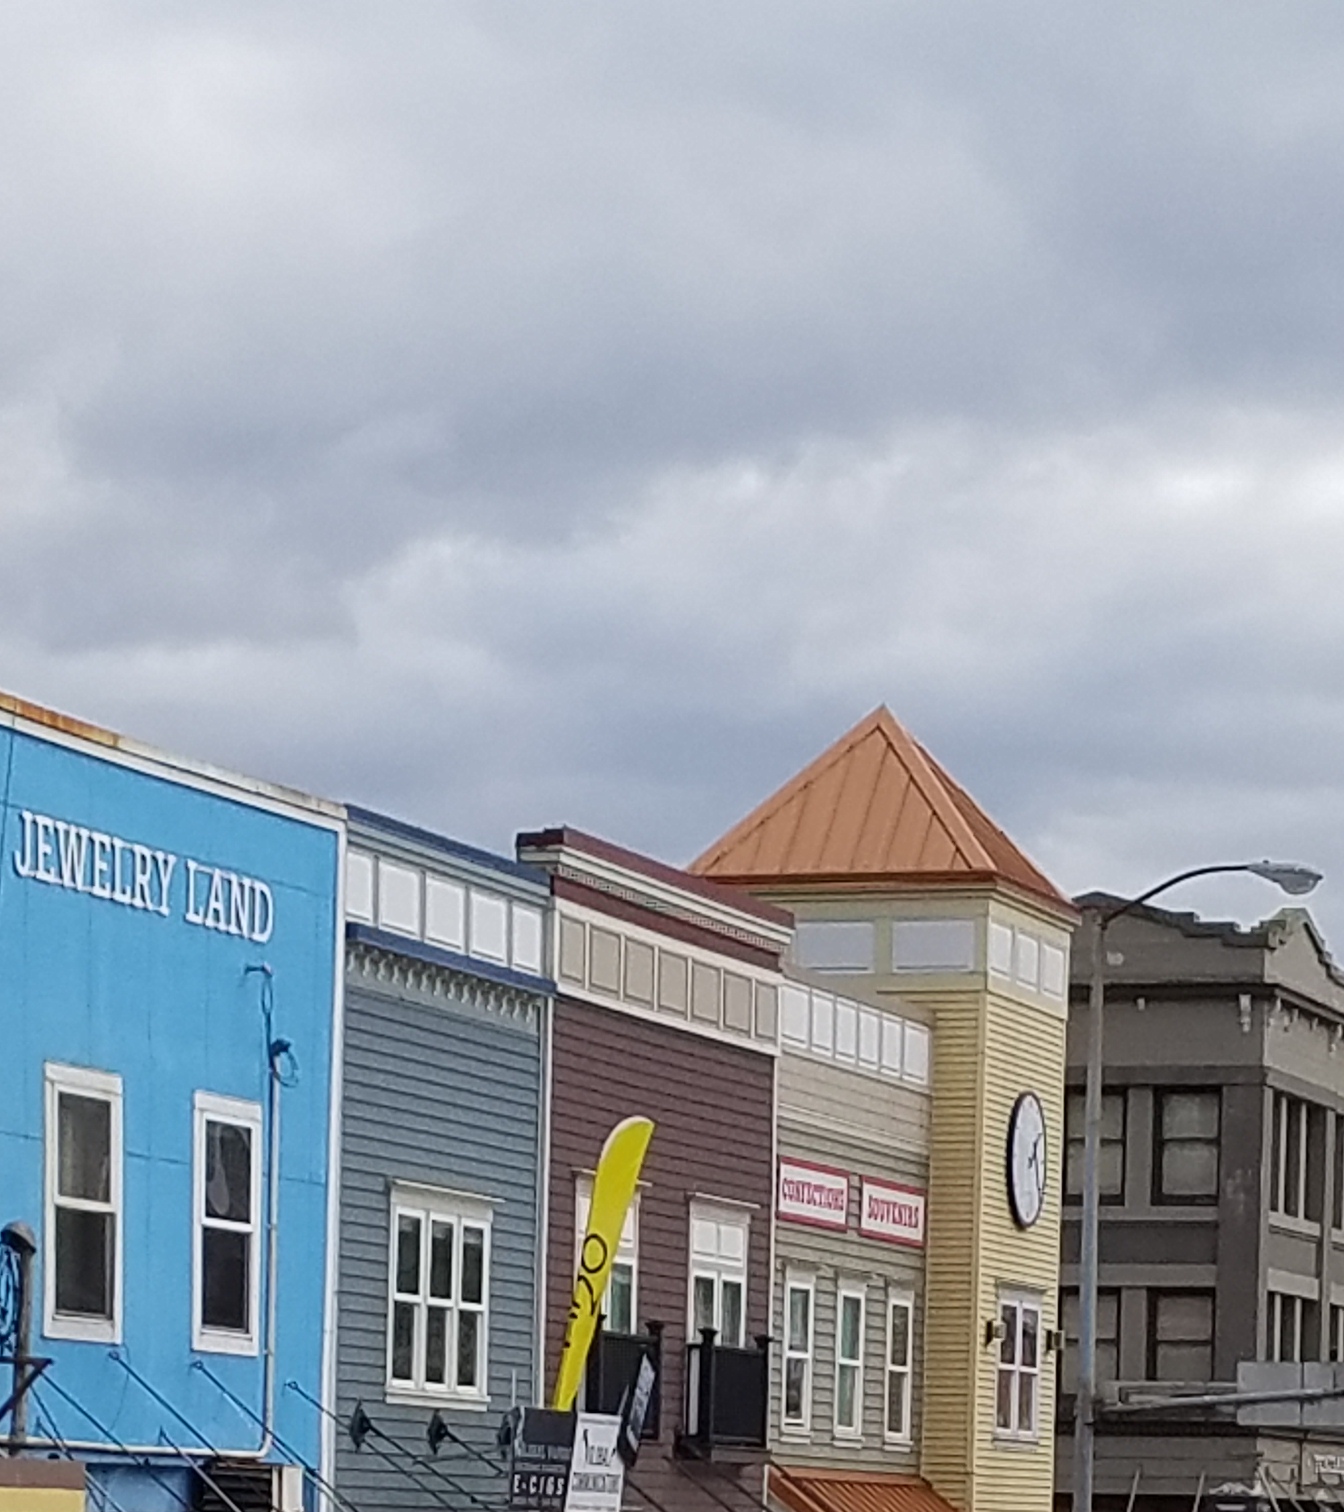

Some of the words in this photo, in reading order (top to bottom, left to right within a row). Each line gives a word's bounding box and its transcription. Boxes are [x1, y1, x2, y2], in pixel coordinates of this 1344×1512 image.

[14, 809, 177, 918] JEWELRY
[184, 858, 275, 944] LAND
[513, 1473, 565, 1496] E-CIGS
